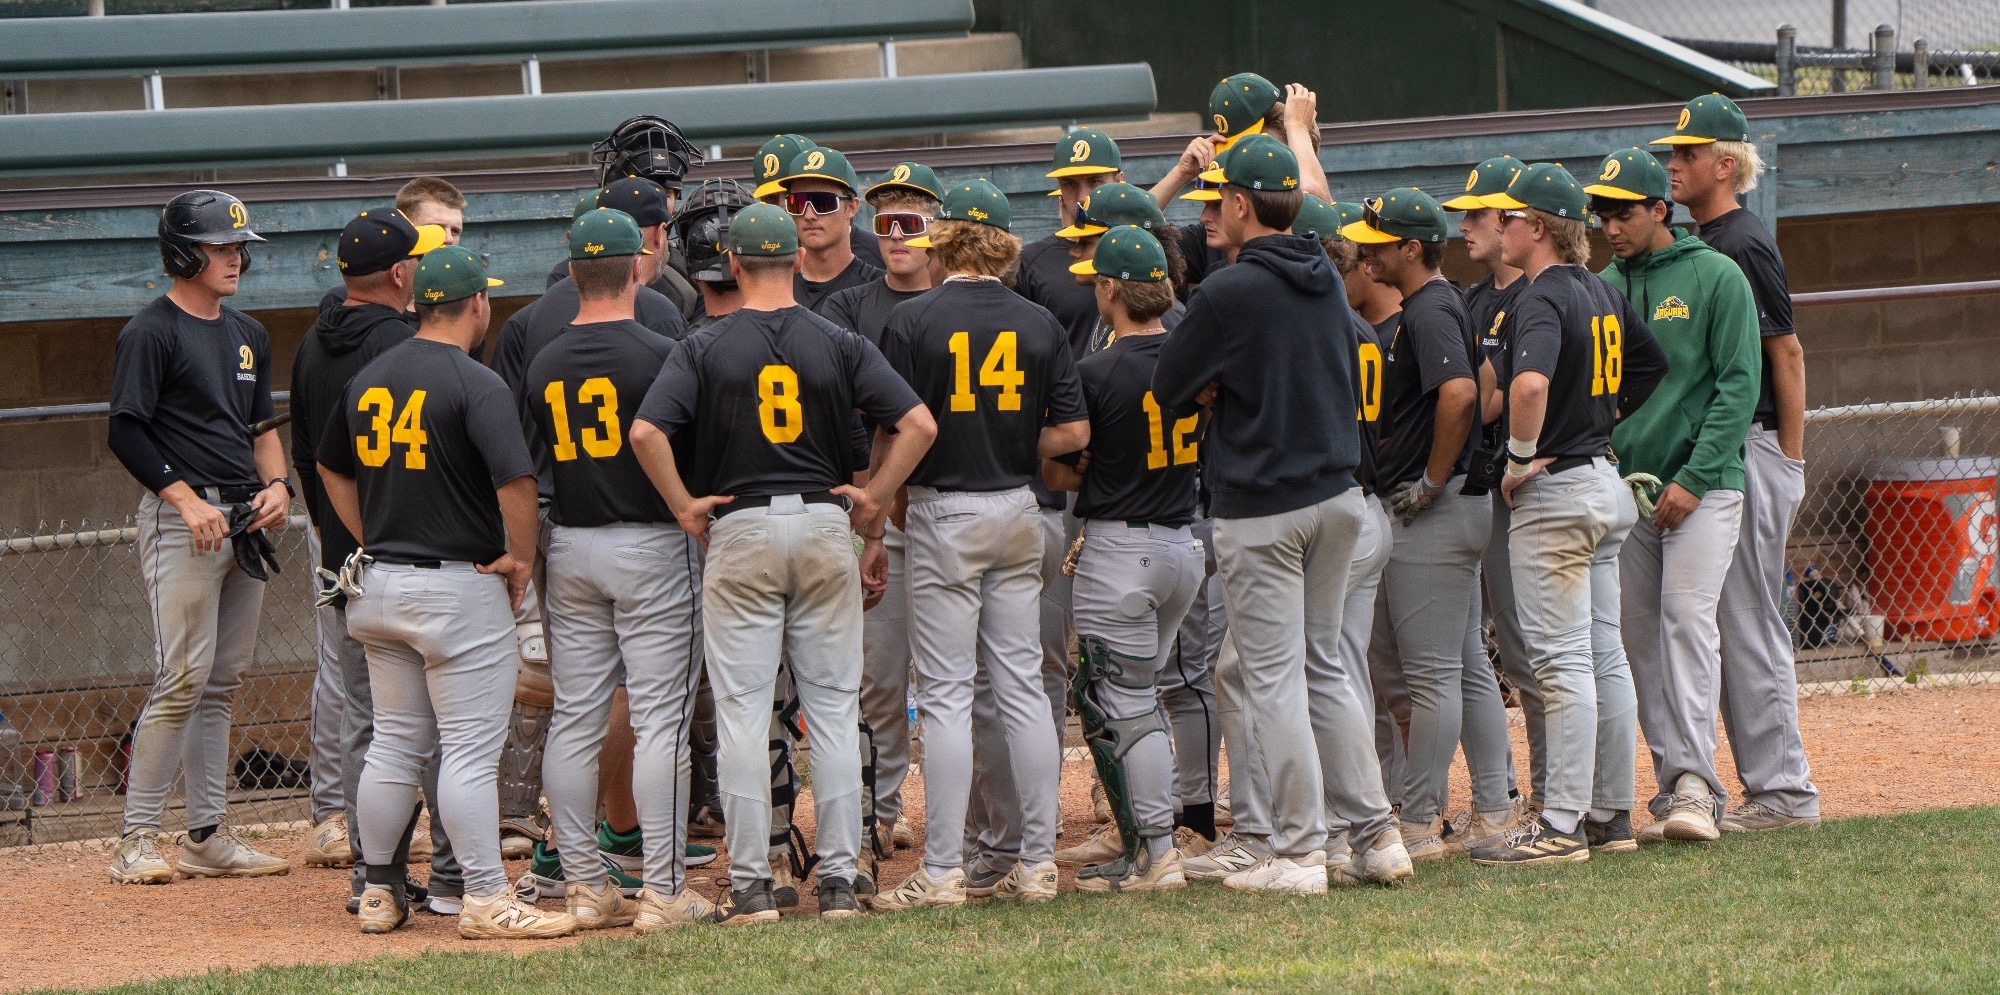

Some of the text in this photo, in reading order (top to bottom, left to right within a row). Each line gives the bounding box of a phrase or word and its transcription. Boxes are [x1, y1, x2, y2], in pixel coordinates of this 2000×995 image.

[1213, 114, 1229, 134] D
[803, 151, 825, 170] D
[1070, 139, 1091, 162] D
[763, 153, 780, 178] D
[890, 164, 911, 183] D
[1599, 159, 1621, 181] D
[229, 202, 247, 229] D
[967, 206, 989, 221] Jags
[584, 242, 605, 256] Jags
[761, 240, 781, 251] Jags
[424, 288, 445, 301] Jags
[1654, 306, 1688, 319] JAGUARS
[239, 345, 254, 369] D
[1591, 314, 1622, 396] 18
[948, 331, 1025, 412] 14
[1357, 342, 1382, 422] 0
[758, 365, 803, 444] 8
[356, 387, 427, 470] 34
[544, 377, 622, 462] 13
[1142, 390, 1199, 470] 12
